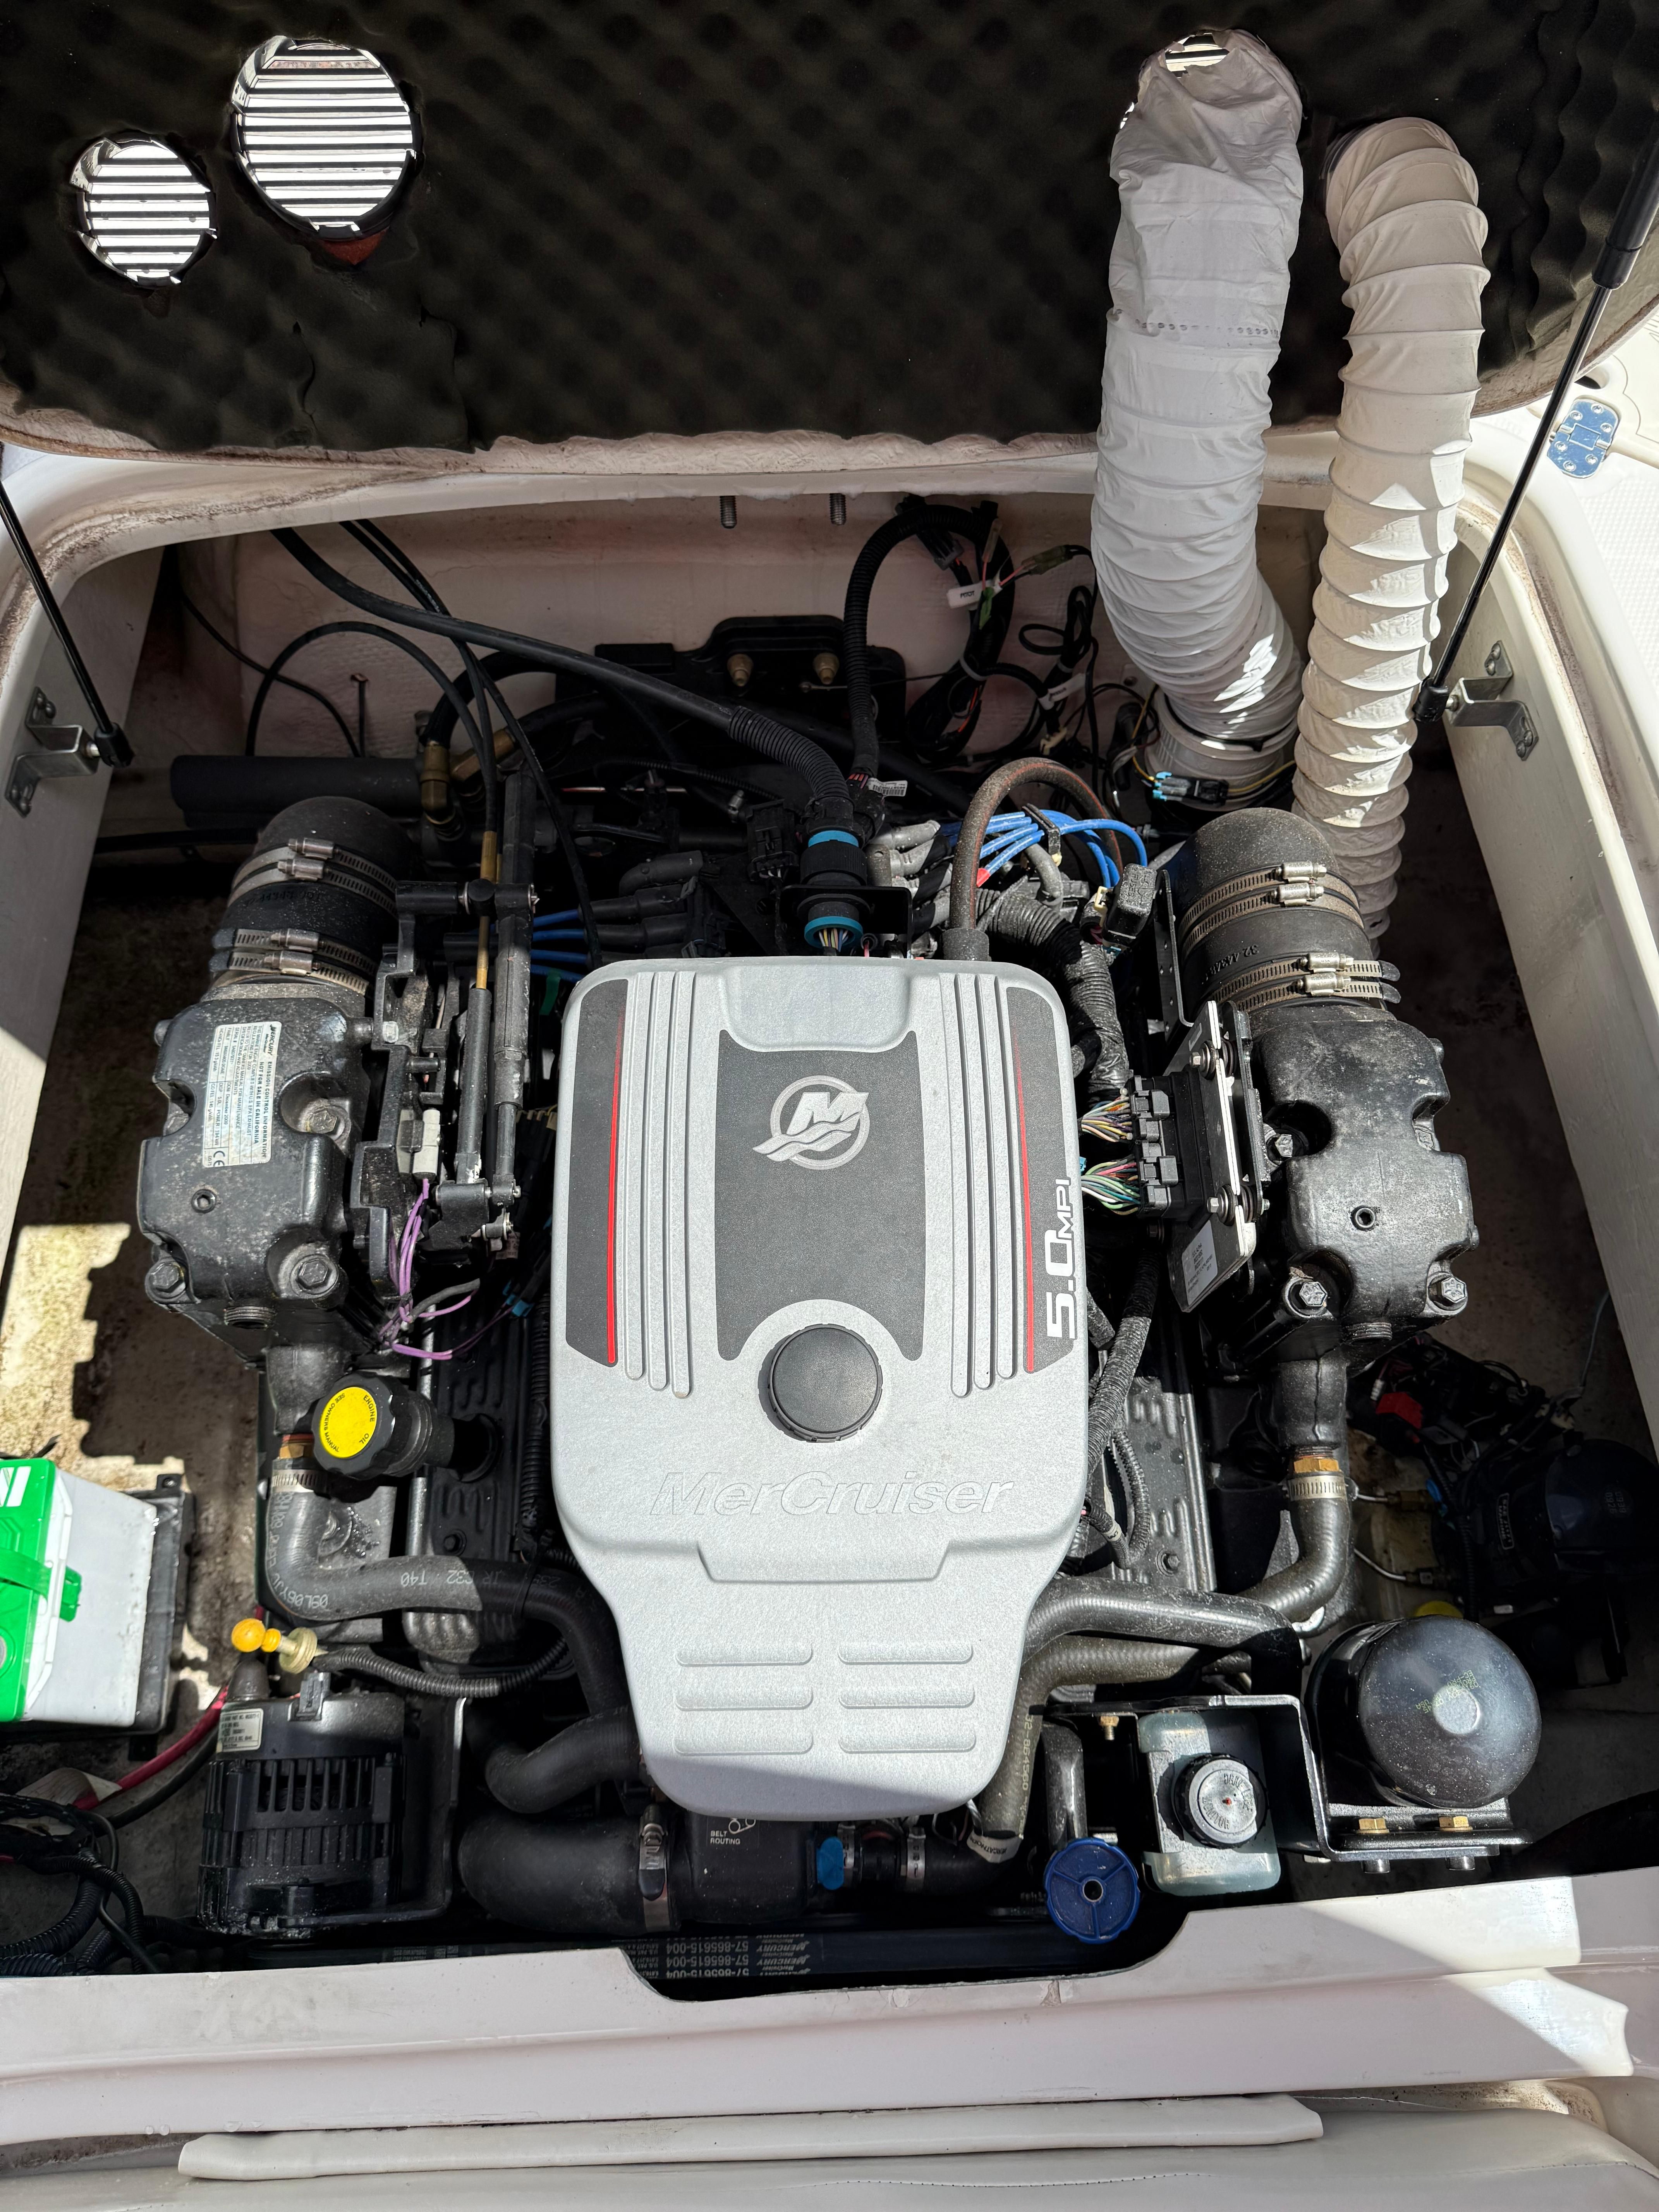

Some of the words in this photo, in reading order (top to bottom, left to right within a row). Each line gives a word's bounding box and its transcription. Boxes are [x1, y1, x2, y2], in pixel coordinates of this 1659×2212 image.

[268, 1024, 277, 1056] MERCURY
[252, 1109, 261, 1144] CALIFORNIA
[259, 1116, 270, 1158] INFORMATION
[335, 1393, 345, 1403] SEE
[363, 1395, 374, 1422] ENGINE
[325, 1431, 339, 1452] MANUAL
[359, 1433, 369, 1444] OIL
[651, 1472, 1014, 1516] MerCruiser
[400, 1570, 428, 1587] T40
[1415, 1699, 1430, 1710] USA
[1022, 1713, 1034, 1791] 32-864560
[666, 1941, 749, 1954] 57-865615-004
[756, 1941, 810, 1952] MERCURY
[666, 1954, 749, 1968] 57-865615-004
[756, 1954, 810, 1966] MERCURY
